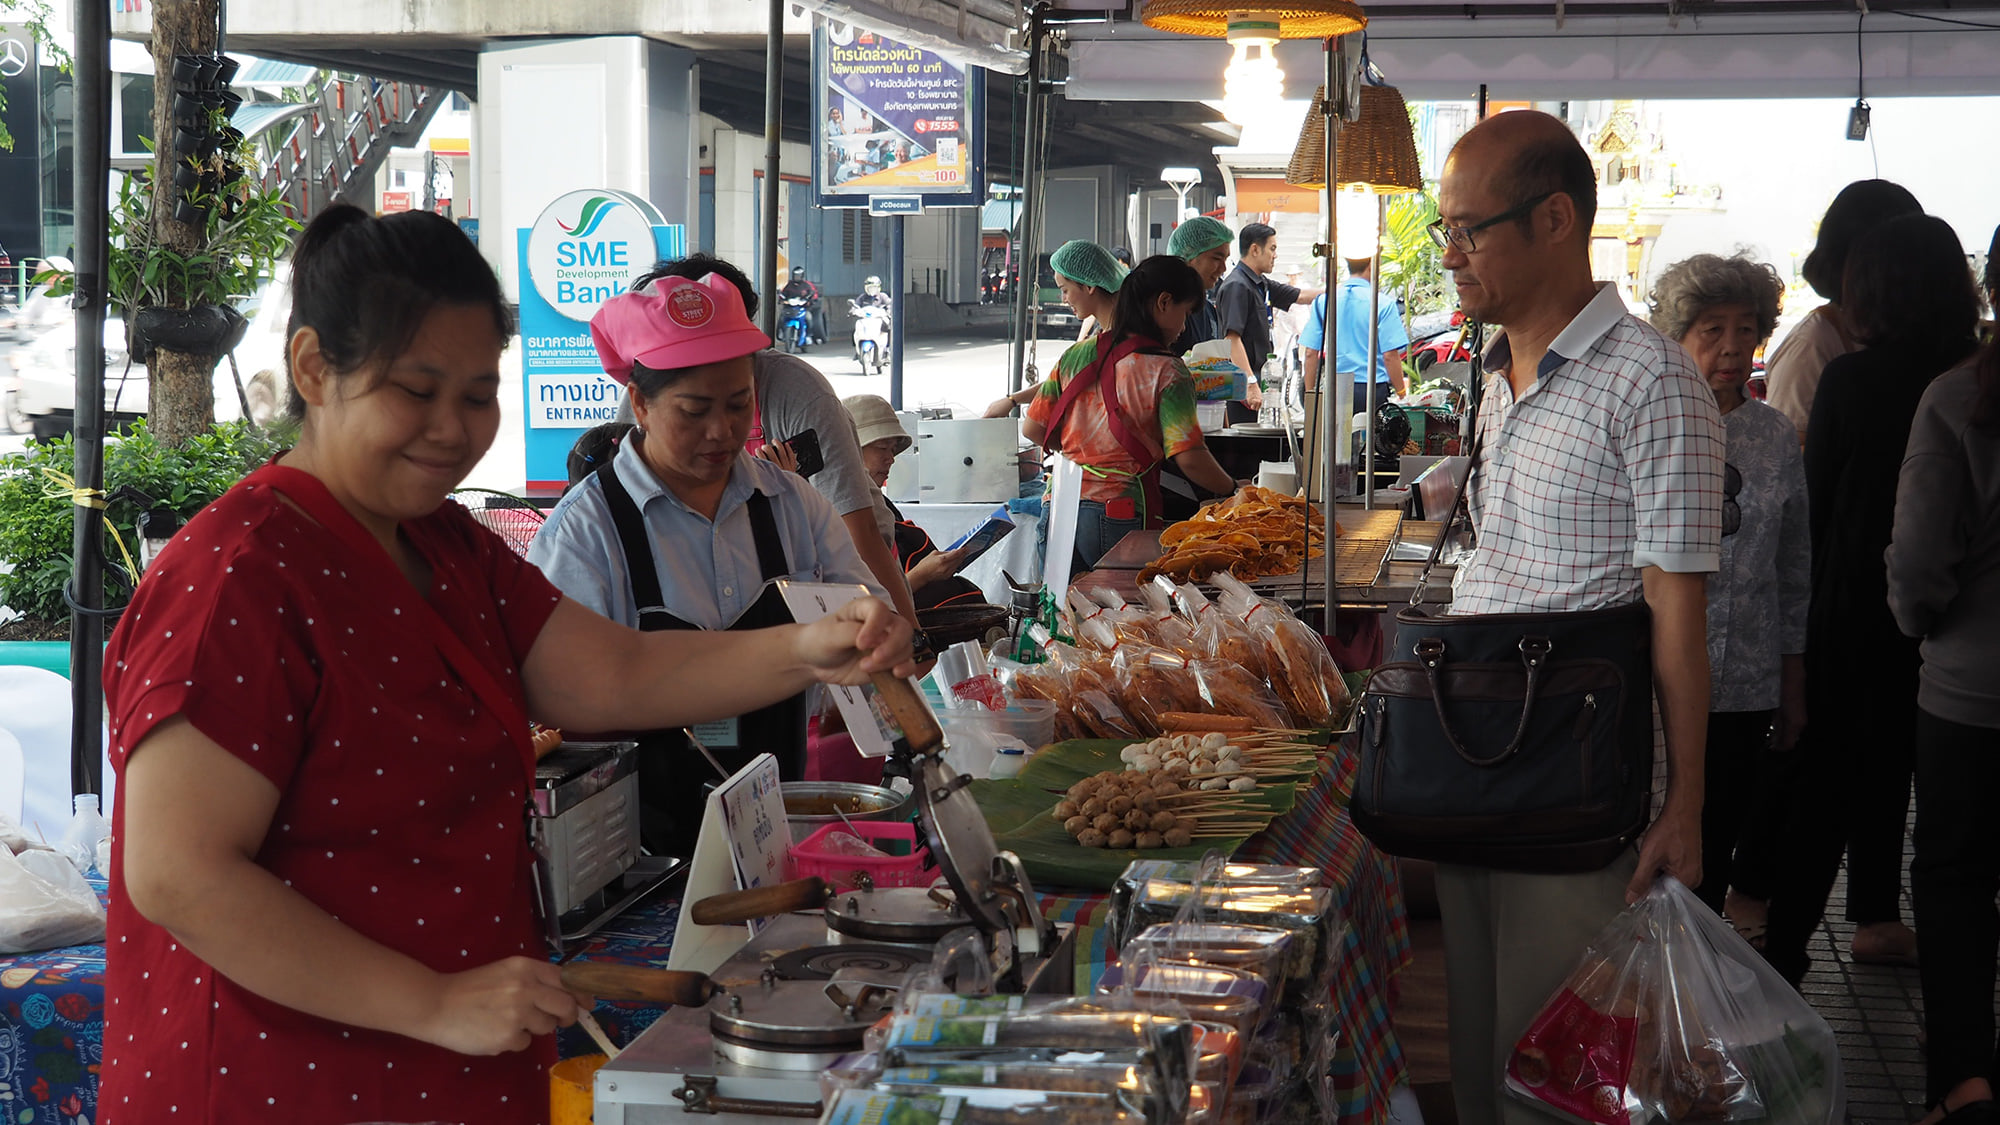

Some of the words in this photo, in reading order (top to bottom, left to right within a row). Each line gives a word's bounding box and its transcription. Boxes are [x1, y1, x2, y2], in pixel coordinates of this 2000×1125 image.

[833, 46, 922, 62] โทรนัดล่วงหน้า
[831, 63, 903, 74] ได้พบหมอภายใน
[907, 64, 920, 73] 60
[924, 62, 942, 73] นาที
[944, 79, 958, 88] BFC
[906, 91, 915, 99] 10
[918, 90, 958, 99] โรงพยาบาล
[929, 121, 955, 131] 1555
[935, 170, 957, 182] 100
[557, 241, 628, 267] SME
[556, 269, 629, 279] Development
[541, 377, 618, 402] ทางเข้า
